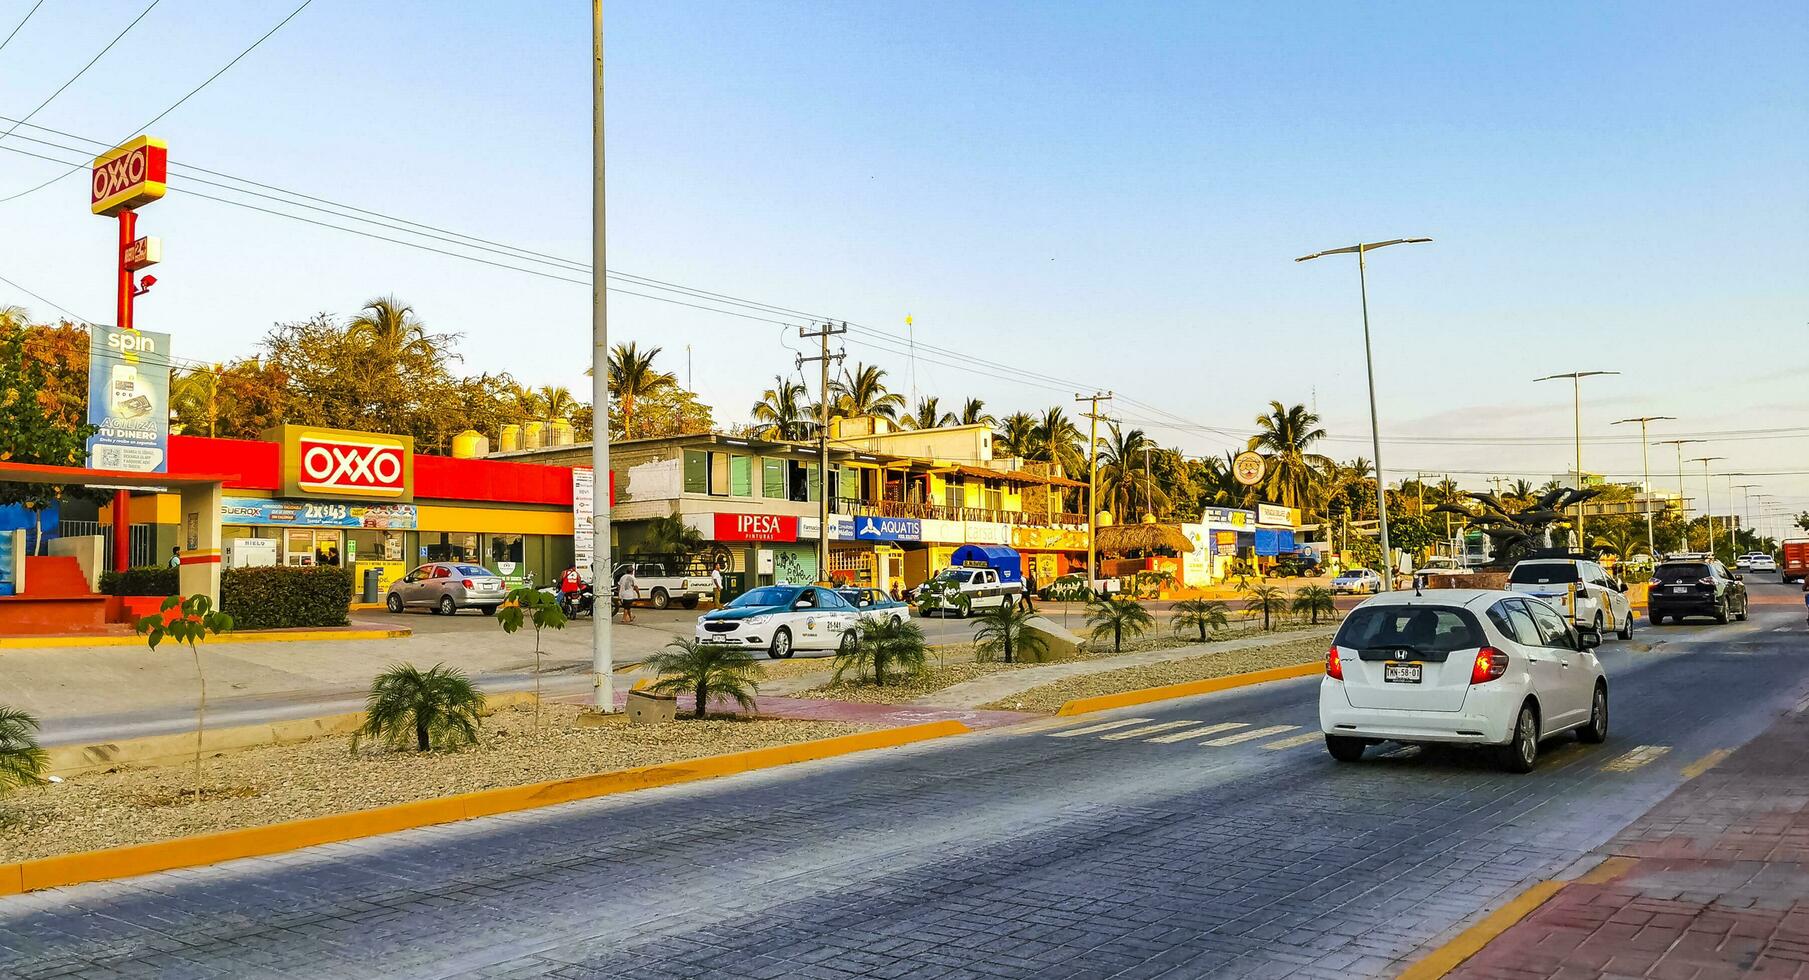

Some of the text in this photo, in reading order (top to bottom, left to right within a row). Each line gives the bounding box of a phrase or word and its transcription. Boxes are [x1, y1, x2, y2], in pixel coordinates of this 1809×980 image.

[93, 150, 145, 200] OXXO
[134, 241, 147, 257] 24
[107, 332, 155, 358] spin
[100, 416, 158, 432] AGILIZA
[100, 428, 158, 440] TU DINERO
[304, 446, 401, 485] OXXO
[737, 514, 781, 534] IPESA
[881, 519, 920, 534] AQUATIS
